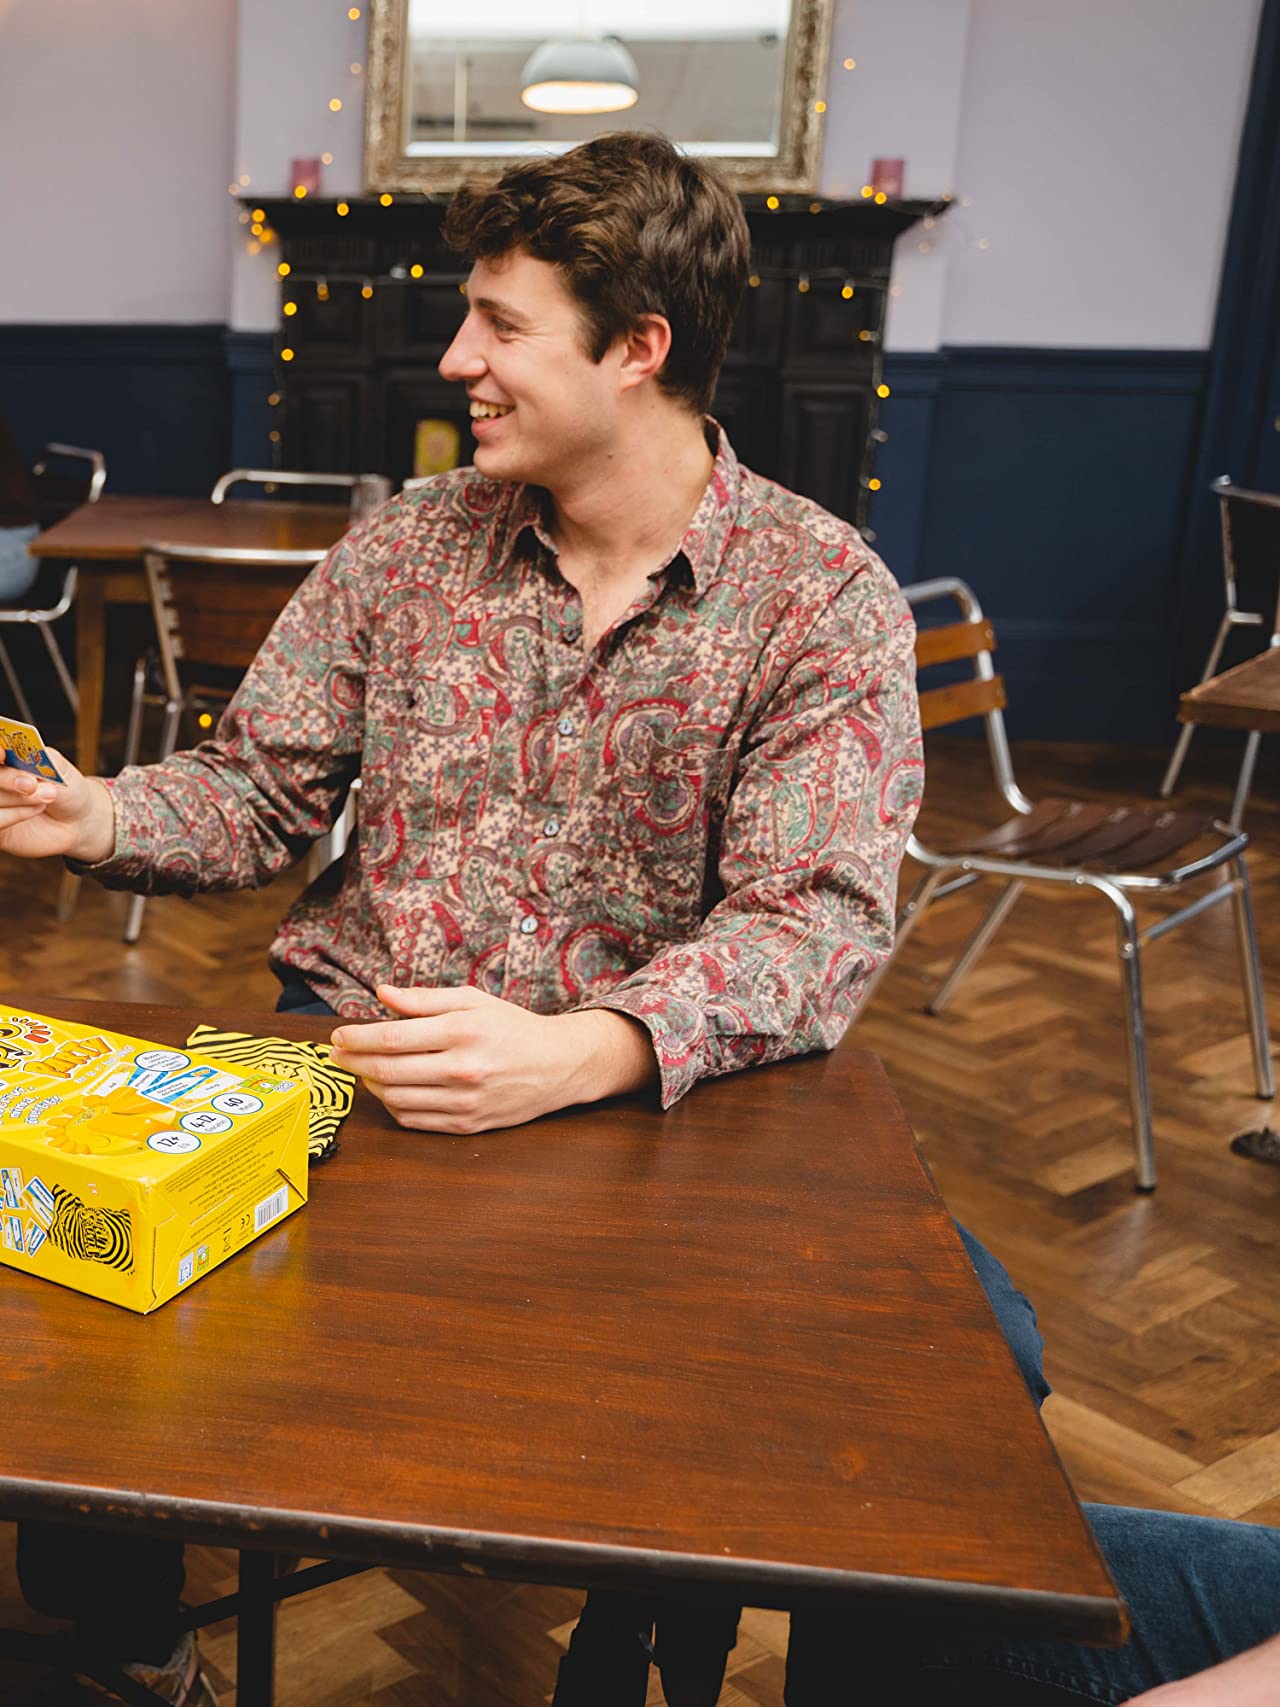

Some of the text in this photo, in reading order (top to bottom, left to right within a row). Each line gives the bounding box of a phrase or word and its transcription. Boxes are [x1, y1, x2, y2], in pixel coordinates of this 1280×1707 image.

[23, 1036, 114, 1079] PARTY
[224, 1097, 243, 1109] 40
[190, 1114, 217, 1128] 4-12
[157, 1135, 180, 1148] 12+
